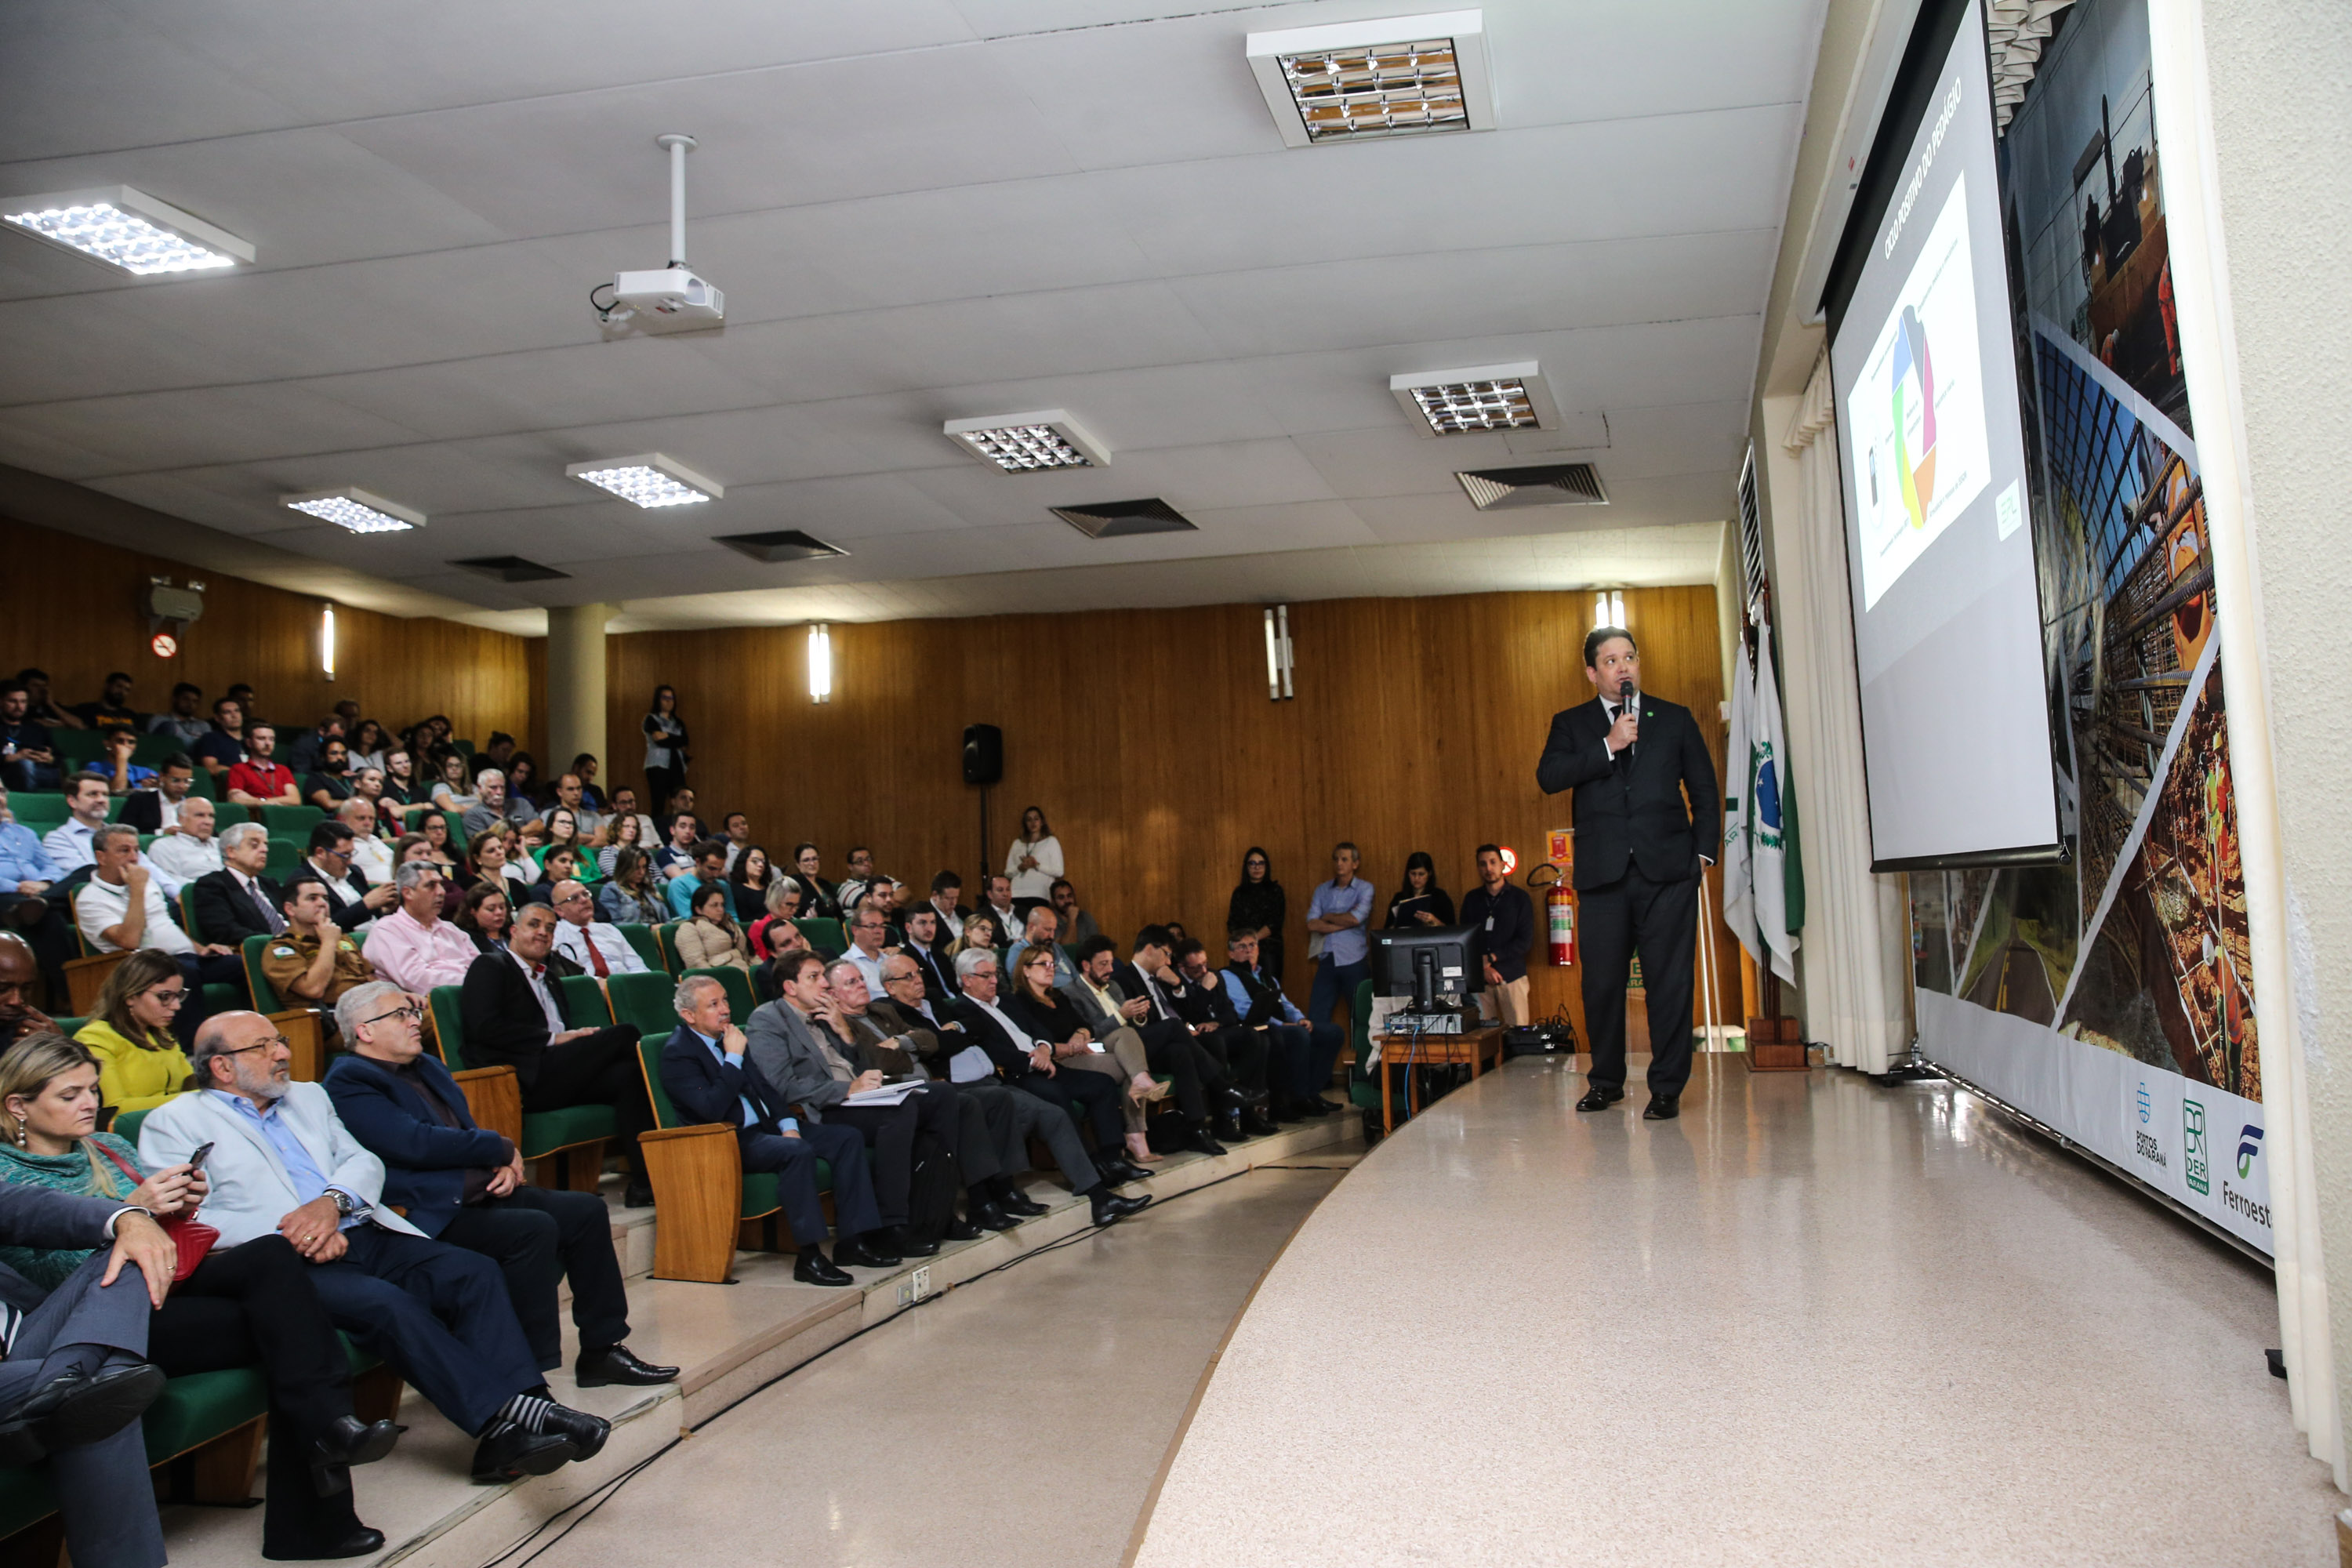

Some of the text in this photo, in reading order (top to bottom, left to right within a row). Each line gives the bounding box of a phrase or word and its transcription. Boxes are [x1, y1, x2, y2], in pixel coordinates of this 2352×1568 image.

[1885, 76, 1962, 260] CICLO POSITIVO DO PEDÁGIO
[2136, 1130, 2158, 1151] PORTOS
[2136, 1142, 2145, 1156] DO
[2187, 1156, 2207, 1180] DER
[2223, 1180, 2273, 1229] Ferroest
